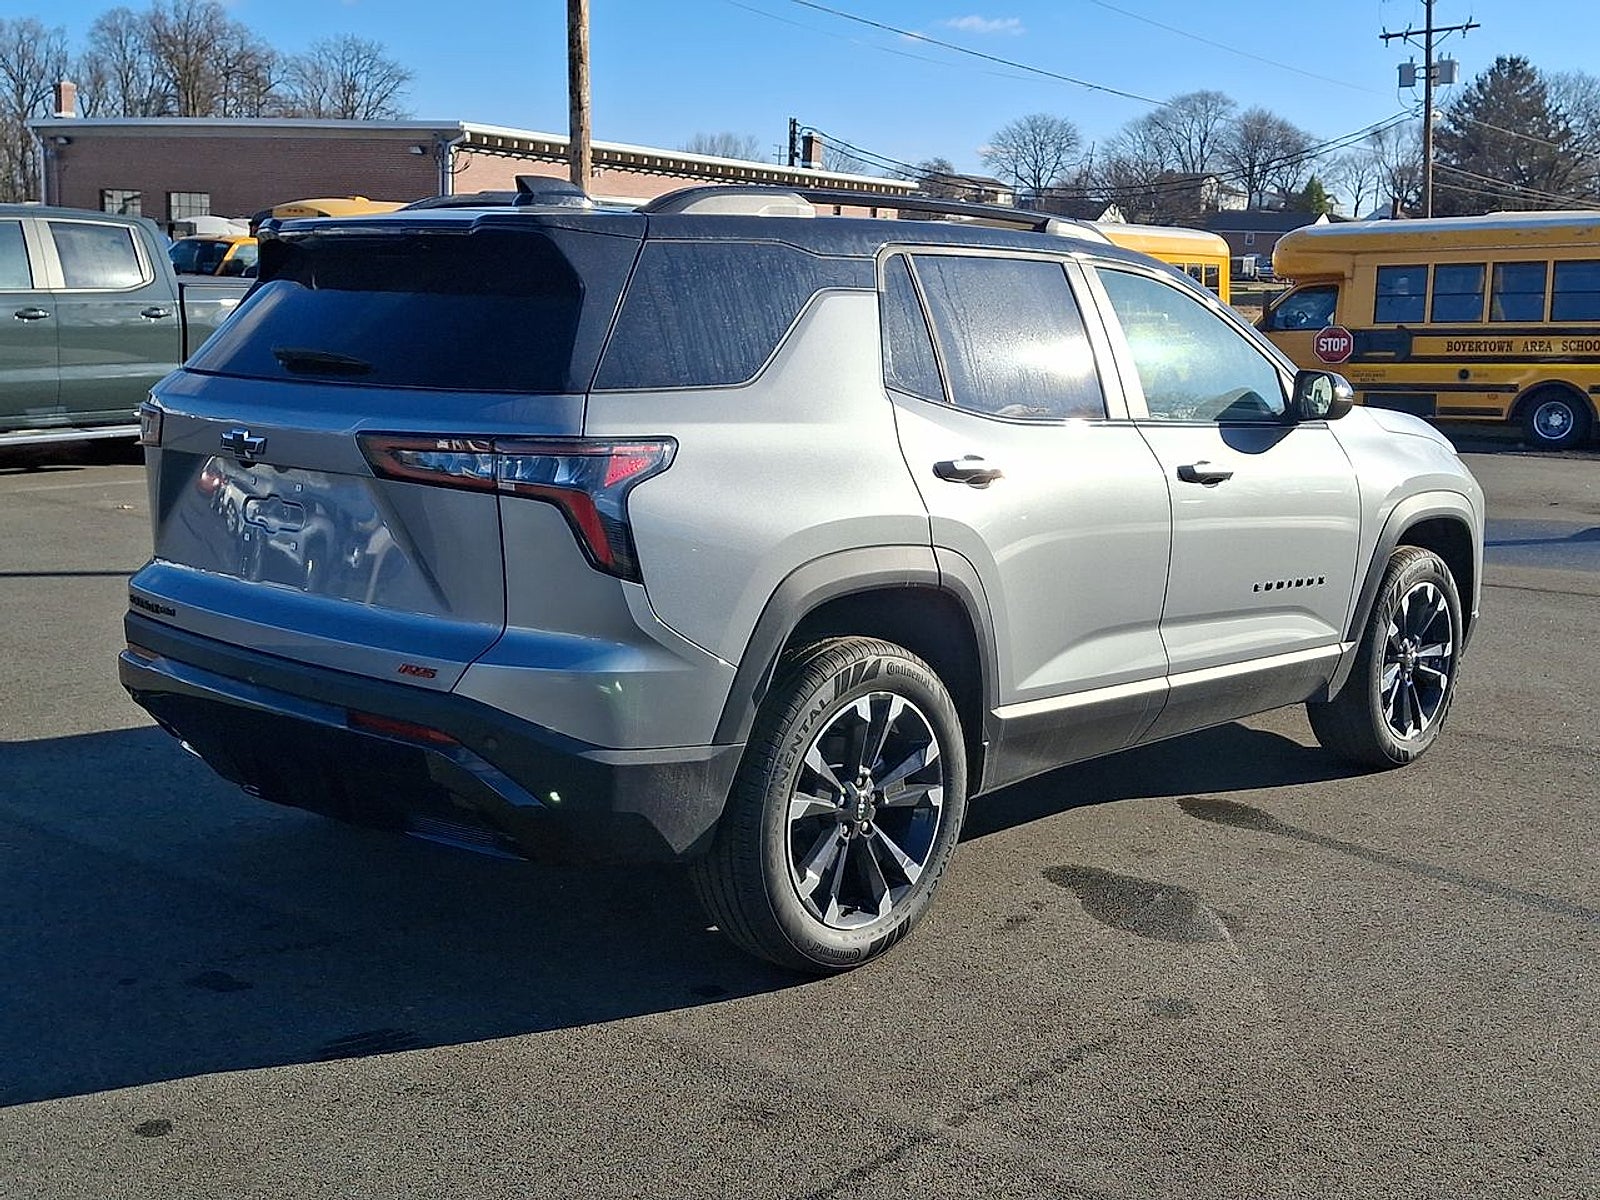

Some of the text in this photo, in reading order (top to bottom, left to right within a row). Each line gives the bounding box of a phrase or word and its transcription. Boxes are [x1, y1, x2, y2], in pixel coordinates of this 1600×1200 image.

[1319, 337, 1348, 352] STOP
[1446, 340, 1600, 353] BOYERTOWN AREA SCHOO
